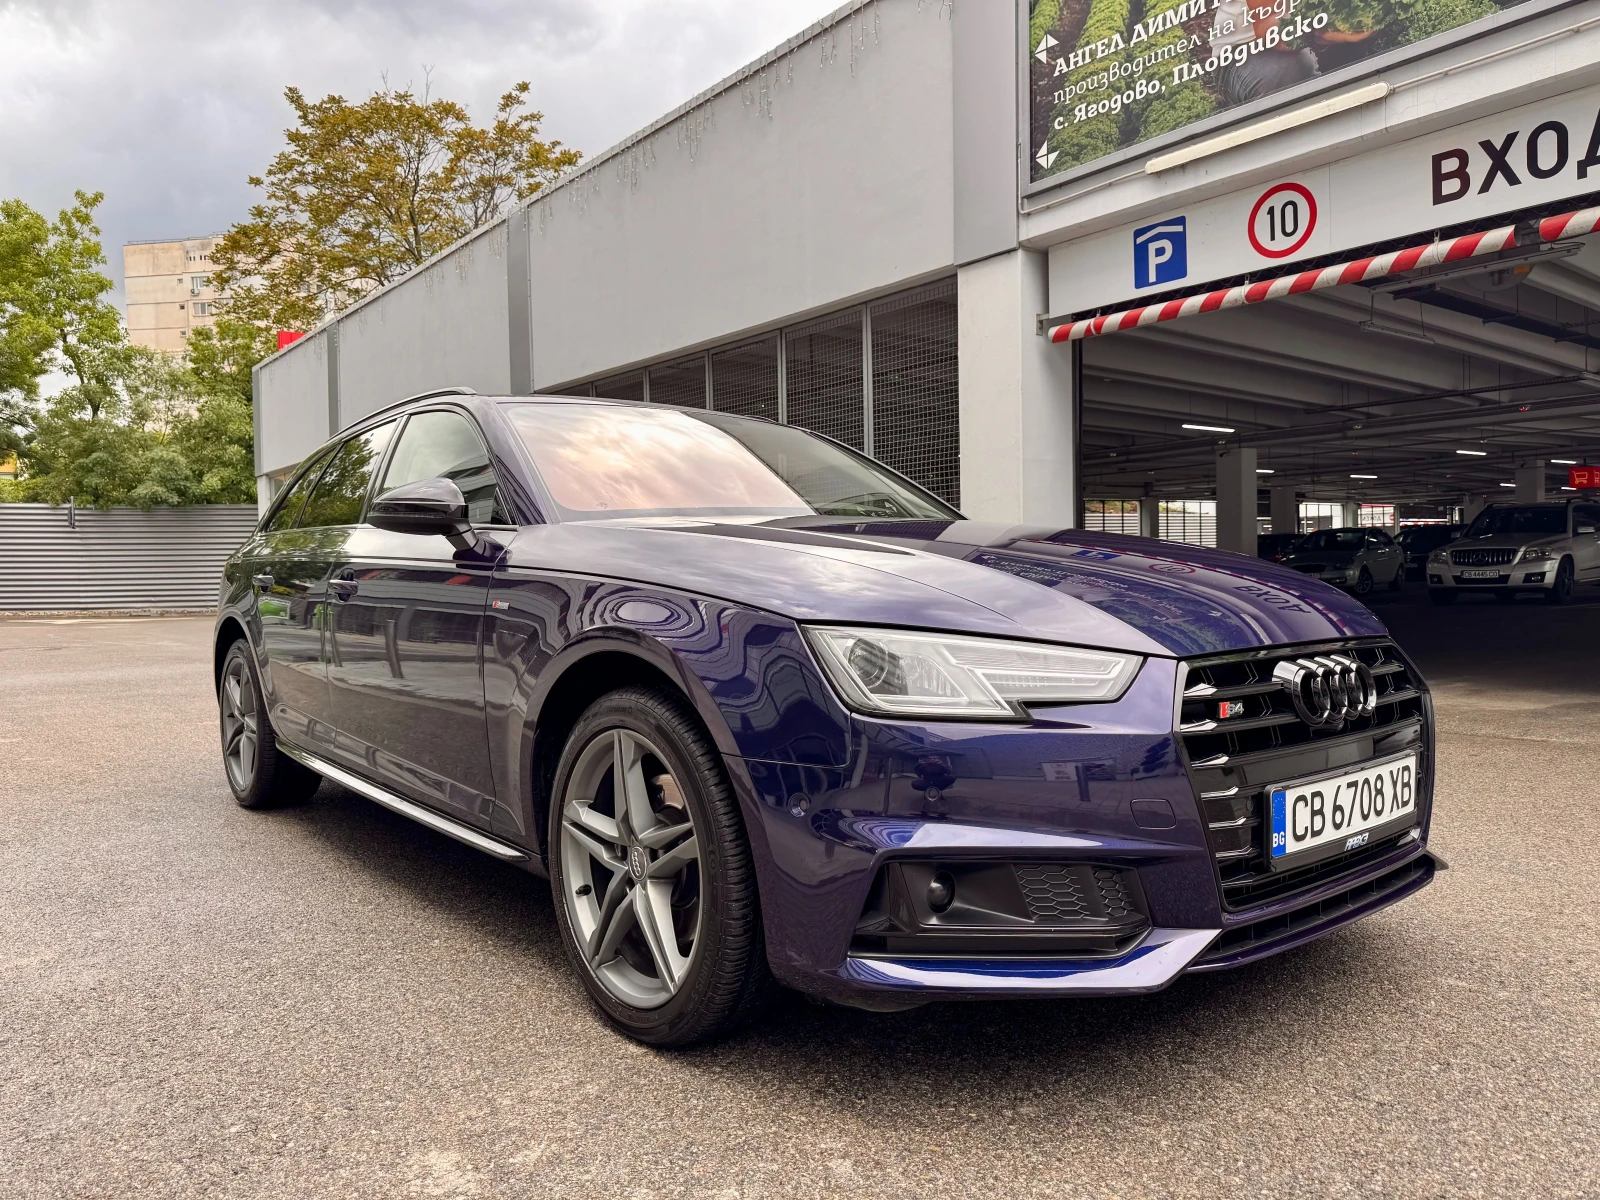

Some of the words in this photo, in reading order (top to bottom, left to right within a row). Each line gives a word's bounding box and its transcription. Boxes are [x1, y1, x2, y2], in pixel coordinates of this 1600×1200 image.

[1053, 33, 1125, 77] АНГЕЛ
[1053, 34, 1202, 104] производител
[1207, 19, 1236, 42] на
[1053, 117, 1069, 130] с.
[1073, 78, 1166, 124] Ягодово,
[1172, 12, 1328, 86] Пловдивско
[1266, 200, 1299, 242] 10
[1148, 238, 1173, 284] P
[1292, 790, 1326, 842] CB
[1332, 773, 1385, 831] 6708
[1390, 764, 1412, 815] XB
[1272, 831, 1285, 848] BG
